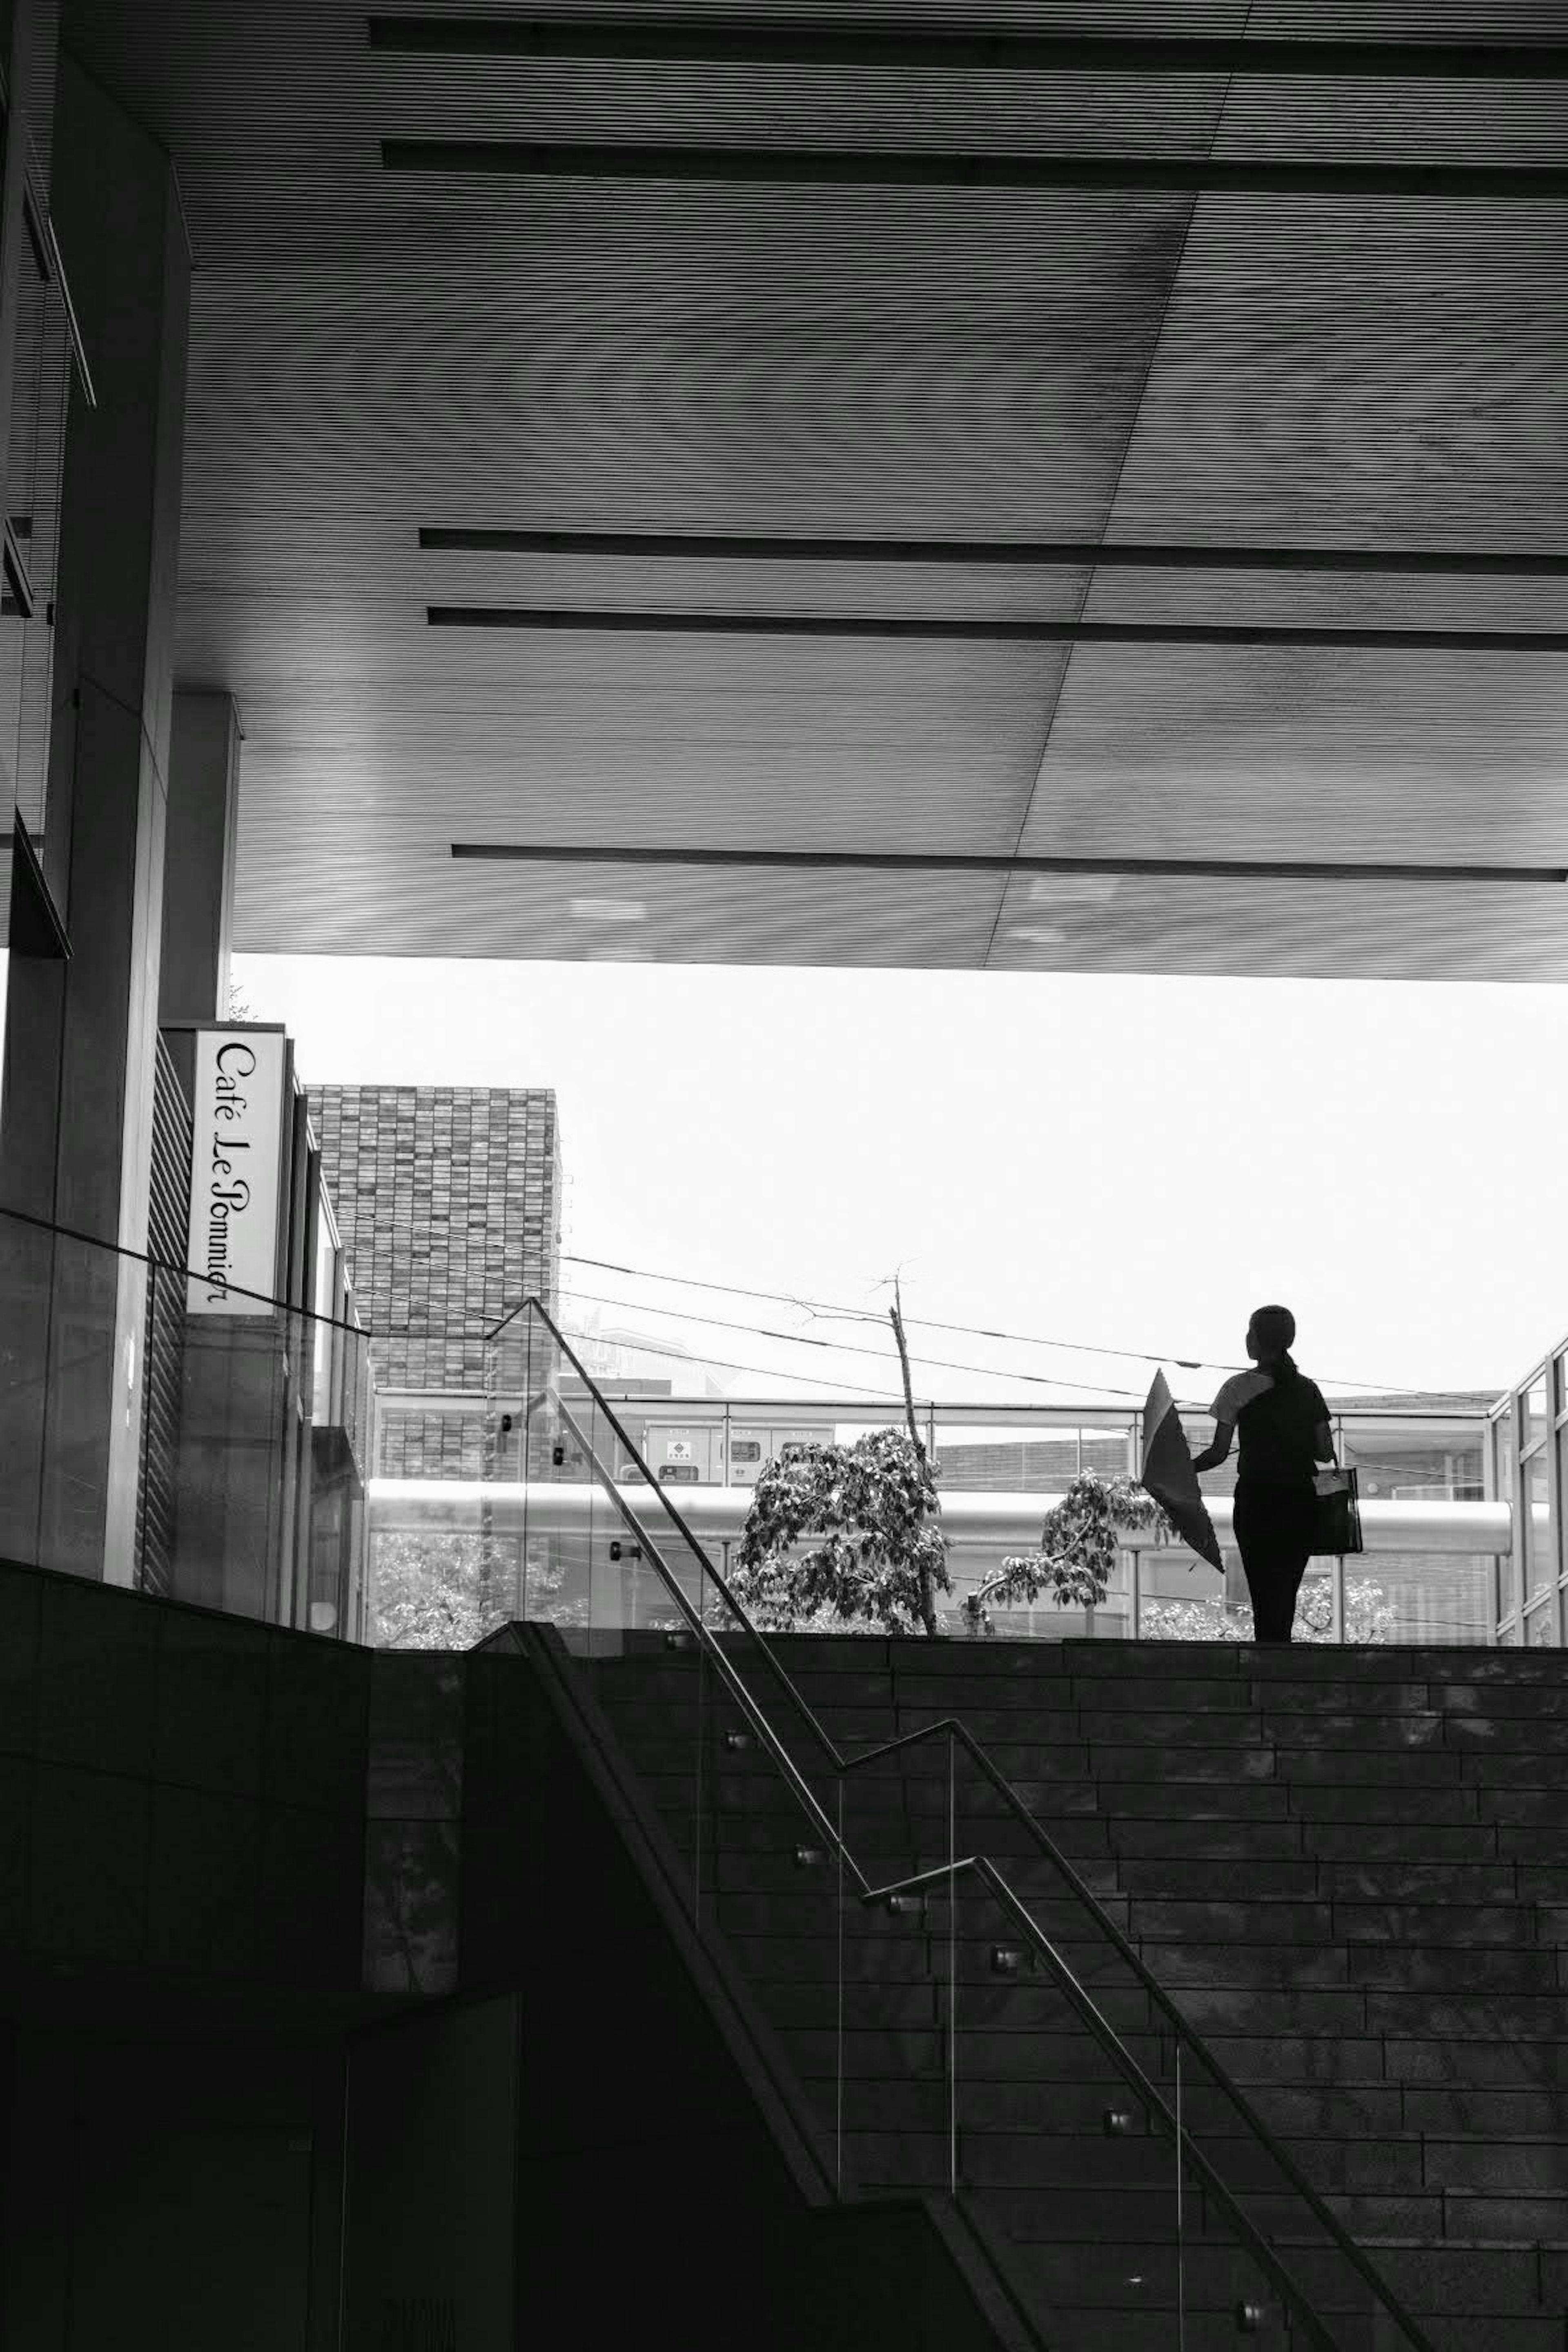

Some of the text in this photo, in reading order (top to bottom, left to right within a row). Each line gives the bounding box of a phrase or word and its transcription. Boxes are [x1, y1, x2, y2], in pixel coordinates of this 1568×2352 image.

[207, 1043, 256, 1303] Café Le Pommier
